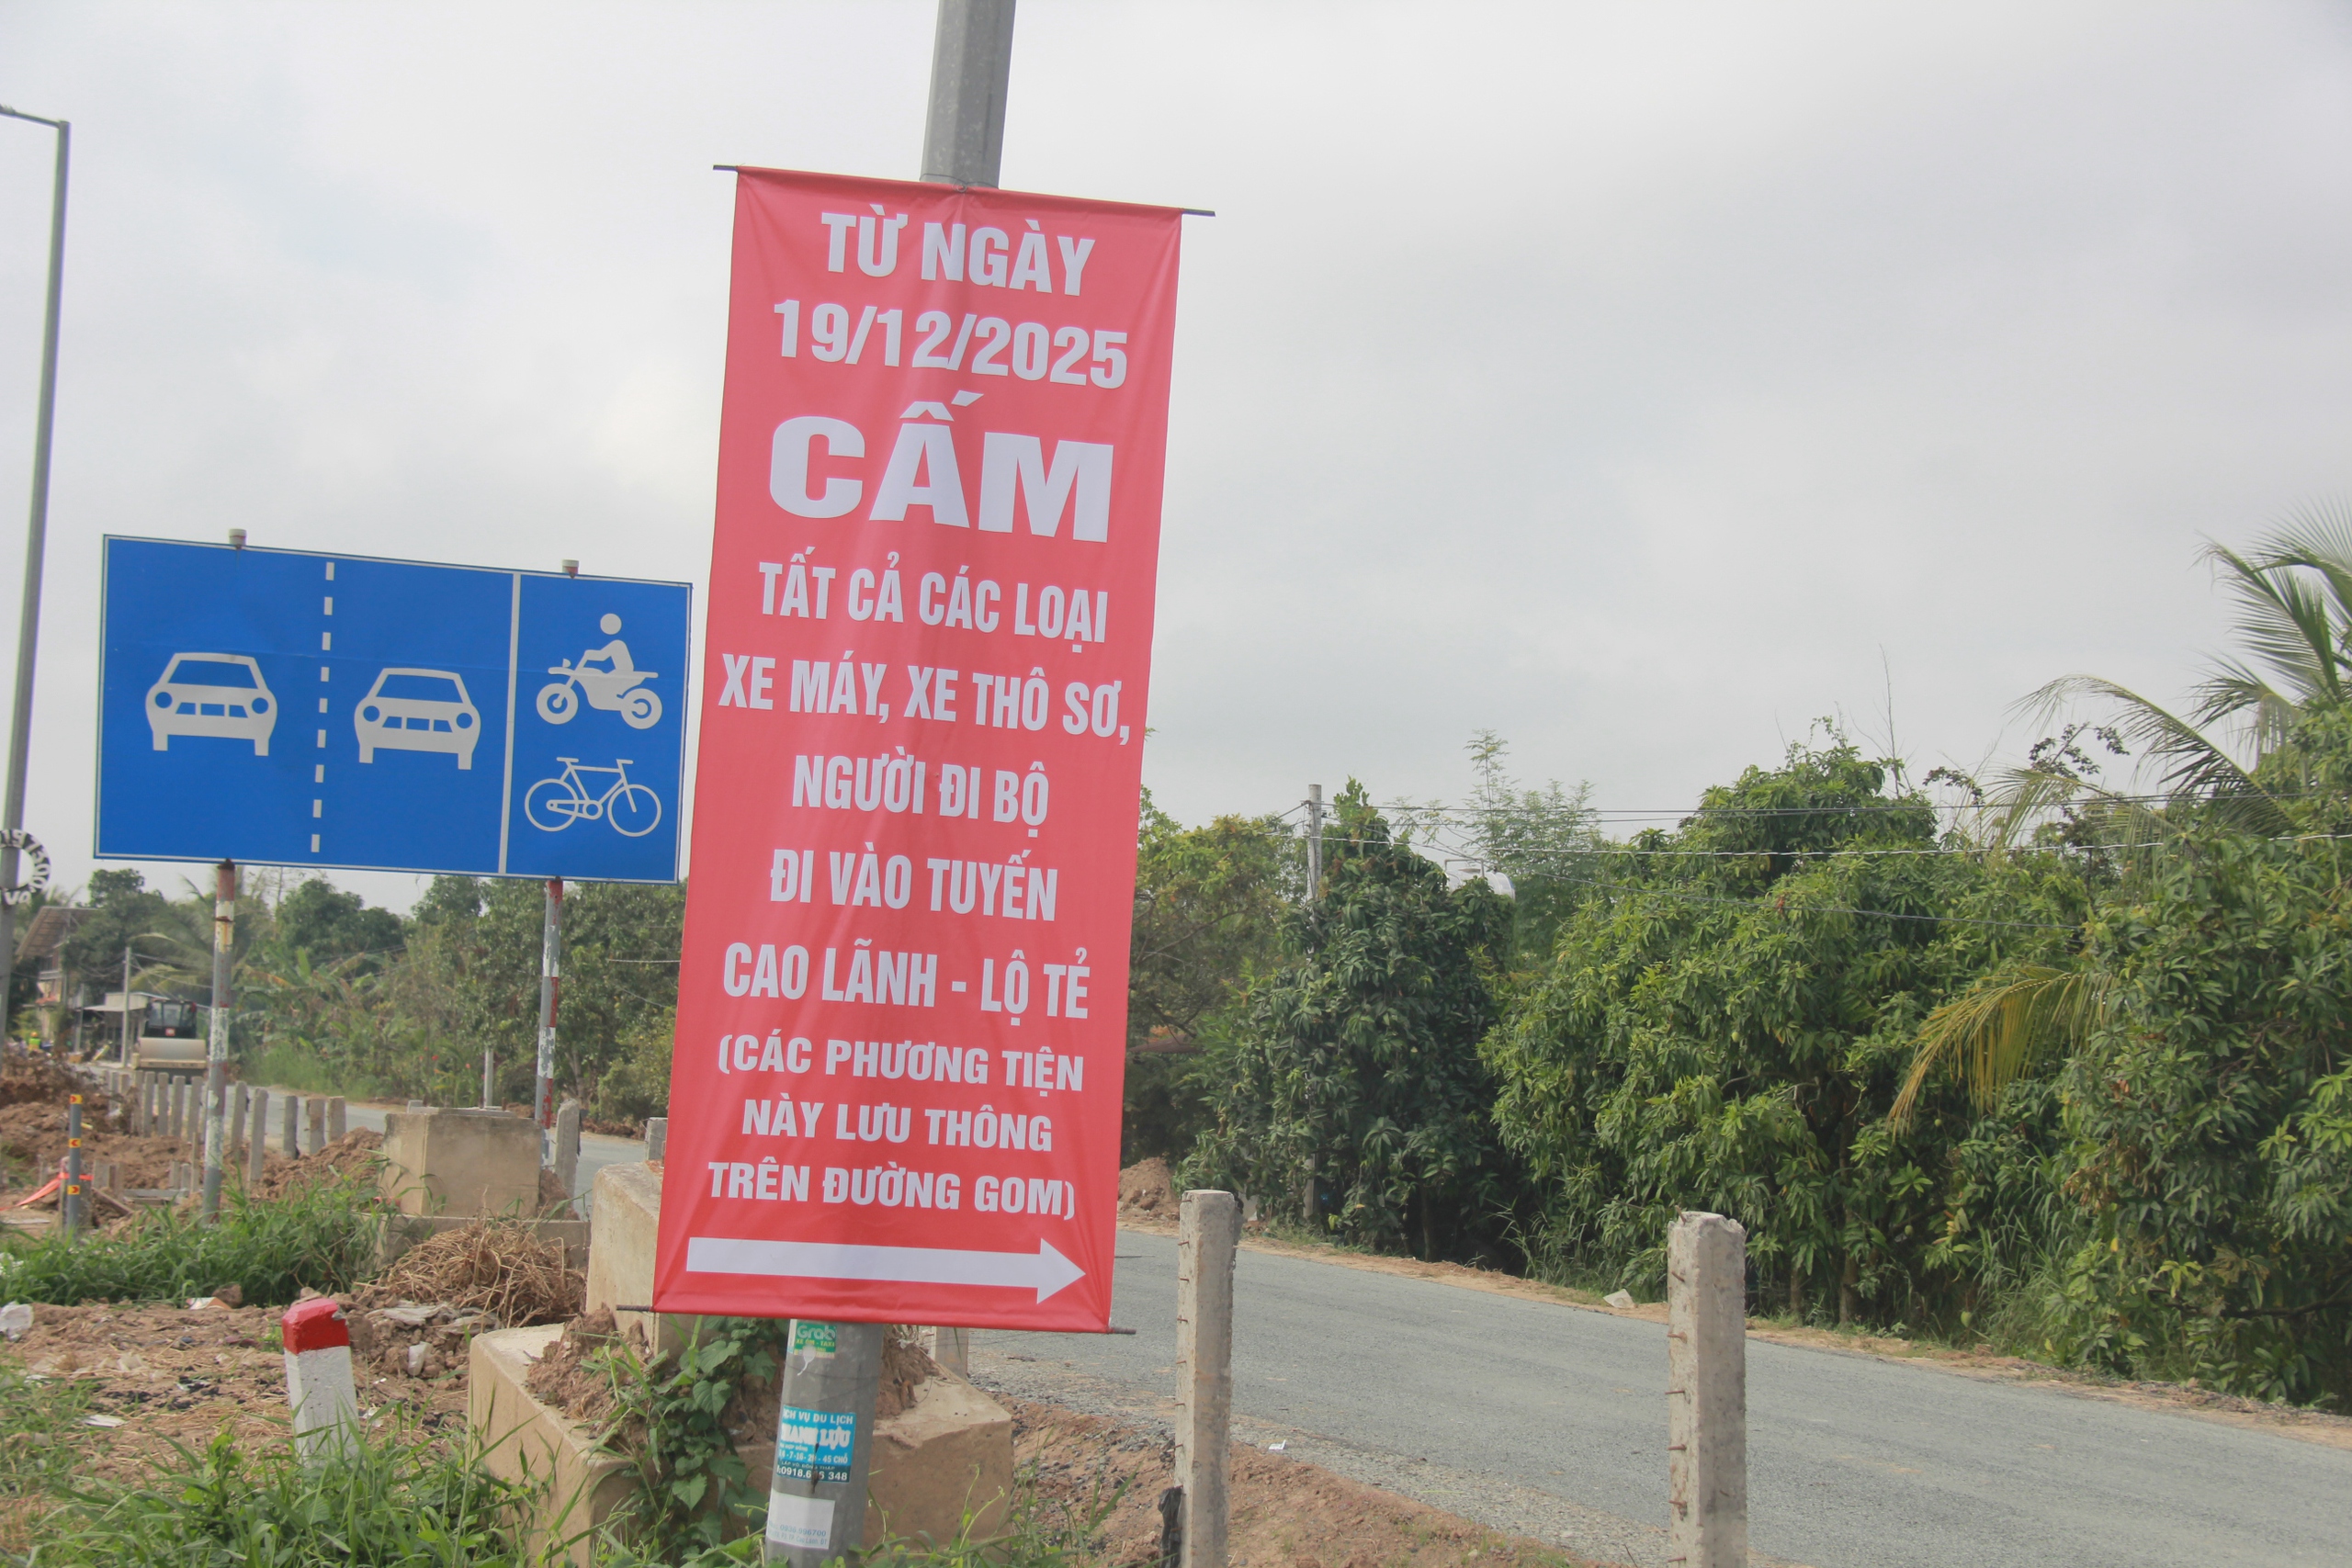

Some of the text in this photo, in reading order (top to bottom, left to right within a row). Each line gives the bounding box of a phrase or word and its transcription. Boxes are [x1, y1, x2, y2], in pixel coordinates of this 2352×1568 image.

[820, 204, 1096, 297] TỪ NGÀY
[774, 299, 1128, 389] 19/12/2025
[769, 389, 1114, 543] CẤM
[759, 546, 1108, 653] TẤT CẢ CÁC LOẠI
[718, 650, 1130, 746] XE MÁY, XE THÔ SƠ,
[792, 745, 1049, 838] NGƯỜI ĐI BỘ
[770, 841, 1058, 921] ĐI VÀO TUYẾN
[723, 938, 1091, 1026] CAO LÃNH - LỘ TẺ
[718, 1028, 1084, 1097] (CÁC PHƯƠNG TIỆN
[741, 1092, 1052, 1152] NÀY LƯU THÔNG
[707, 1156, 1076, 1221] TRÊN ĐƯỜNG GOM)
[797, 1325, 836, 1342] Grab
[798, 1411, 810, 1423] VỤ
[812, 1414, 827, 1423] DU
[830, 1415, 854, 1426] LỊCH
[828, 1471, 848, 1481] 348
